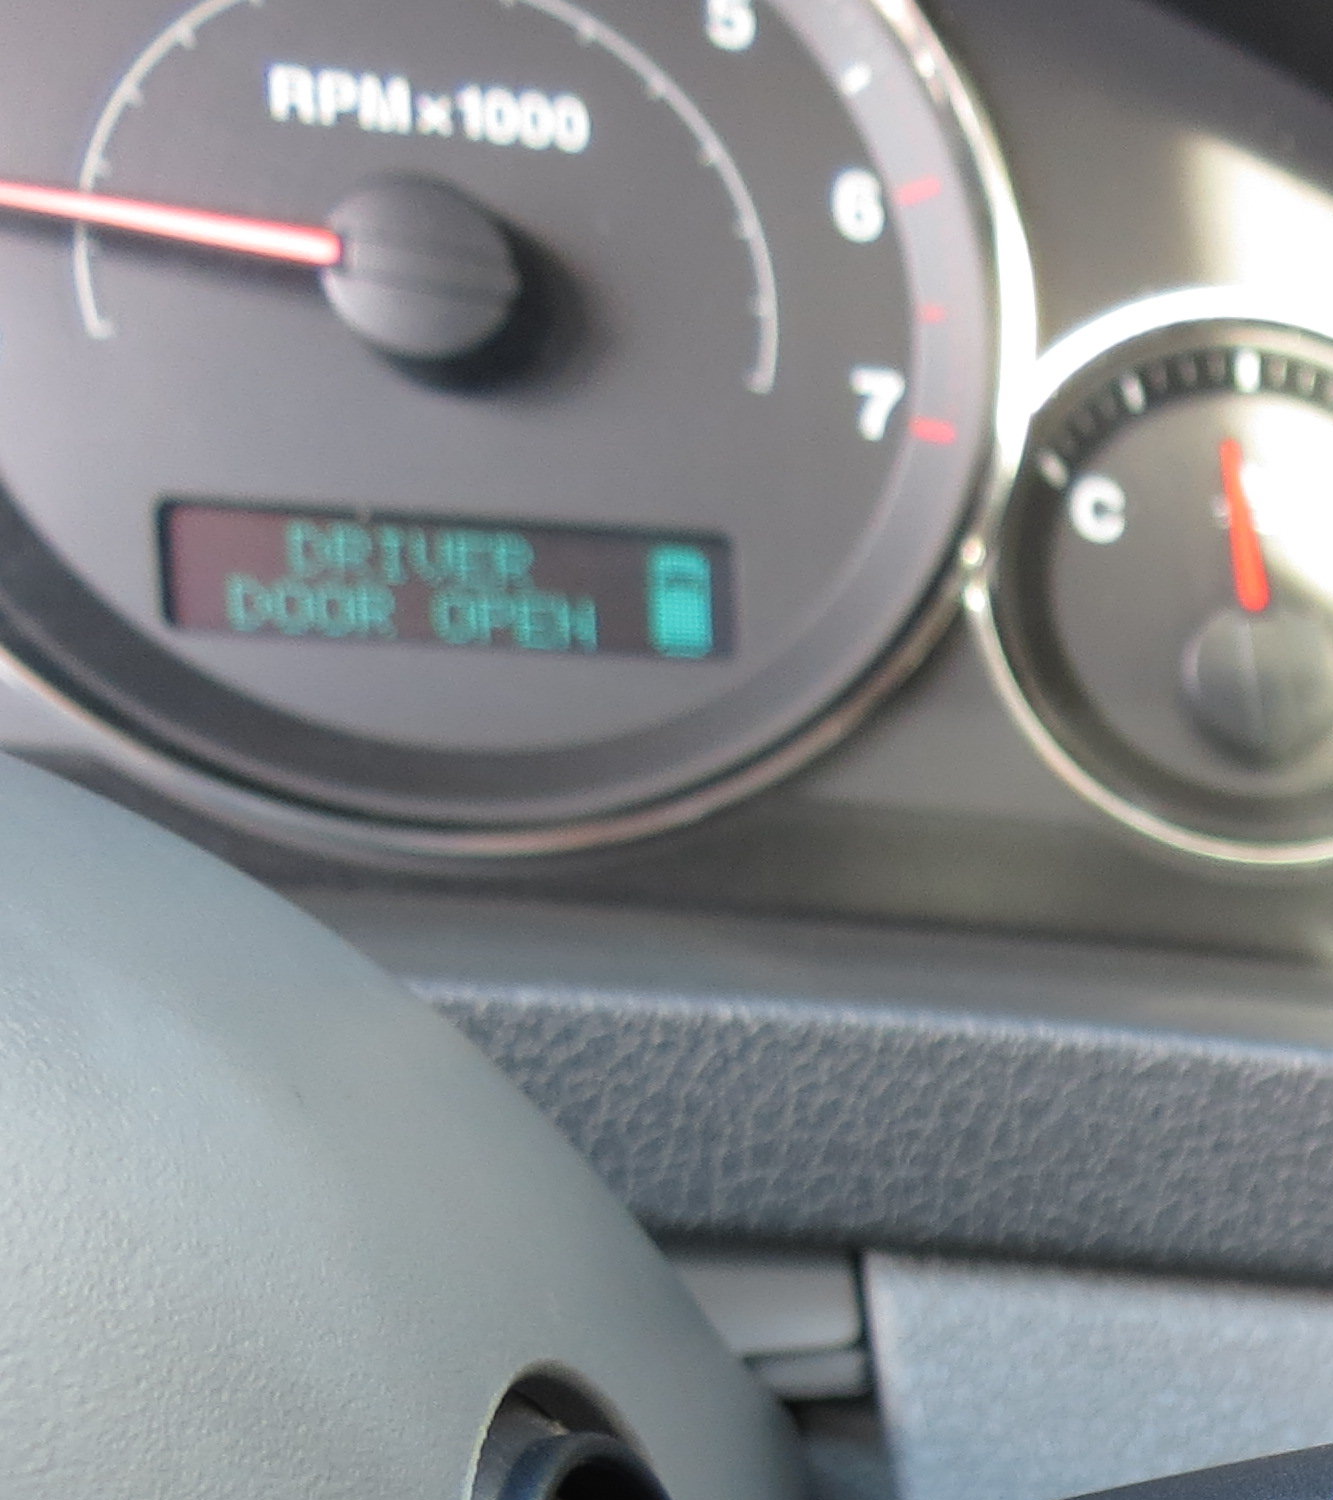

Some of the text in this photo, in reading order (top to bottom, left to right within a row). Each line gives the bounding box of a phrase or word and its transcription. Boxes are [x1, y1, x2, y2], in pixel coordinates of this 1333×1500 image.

[832, 166, 886, 243] 6
[849, 366, 906, 442] 7
[1069, 474, 1126, 544] C
[286, 519, 536, 592] DRIVER
[224, 573, 600, 652] DOOR OPEN
